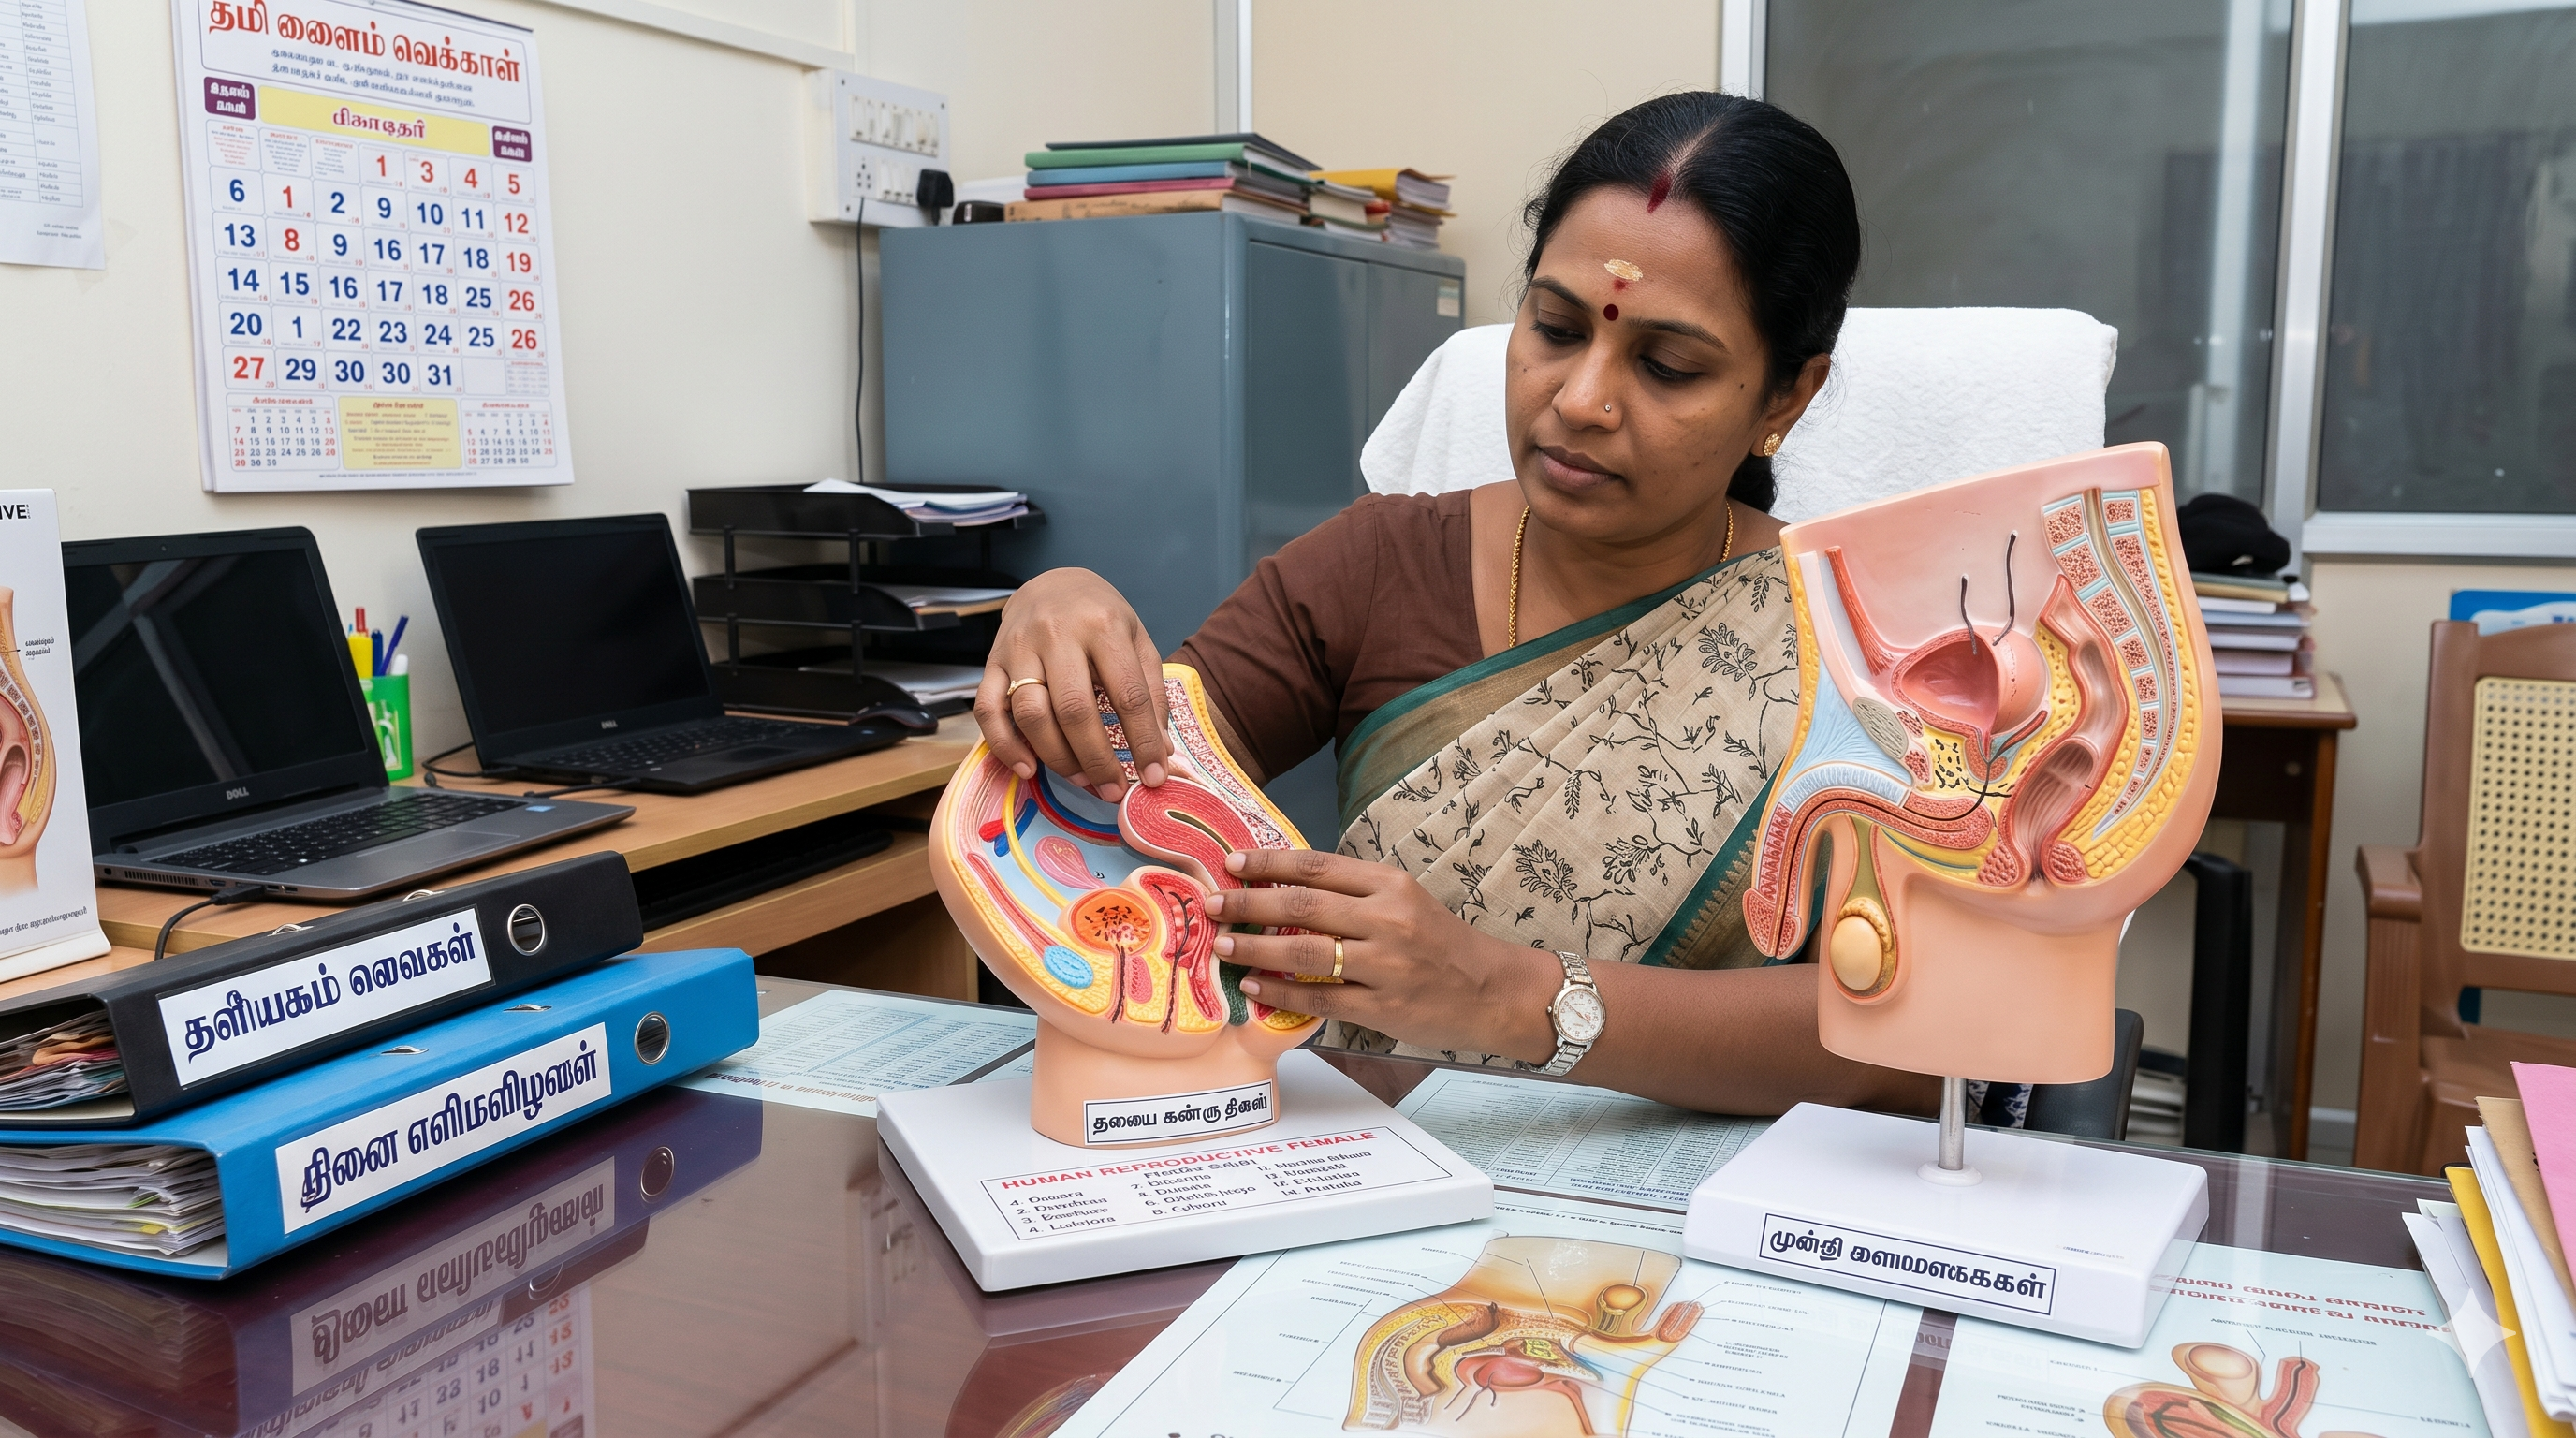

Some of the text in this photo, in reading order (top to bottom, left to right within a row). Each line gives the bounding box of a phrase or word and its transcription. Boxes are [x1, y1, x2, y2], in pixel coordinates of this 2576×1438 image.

[377, 156, 385, 176] 1
[421, 161, 433, 183] 3
[465, 169, 477, 188] 4
[509, 174, 520, 194] 5
[230, 180, 528, 233] 6 1 2 9 10 11 12
[225, 224, 531, 272] 13 8 9 16 17 18 19
[228, 268, 534, 311] 14 15 16 17 18 25 26
[231, 313, 536, 349] 20 1 22 23 24 25 26
[234, 356, 451, 385] 27 29 30 30 31
[1001, 1131, 1378, 1190] HUMAN REPRODUCTIVE FEMALE
